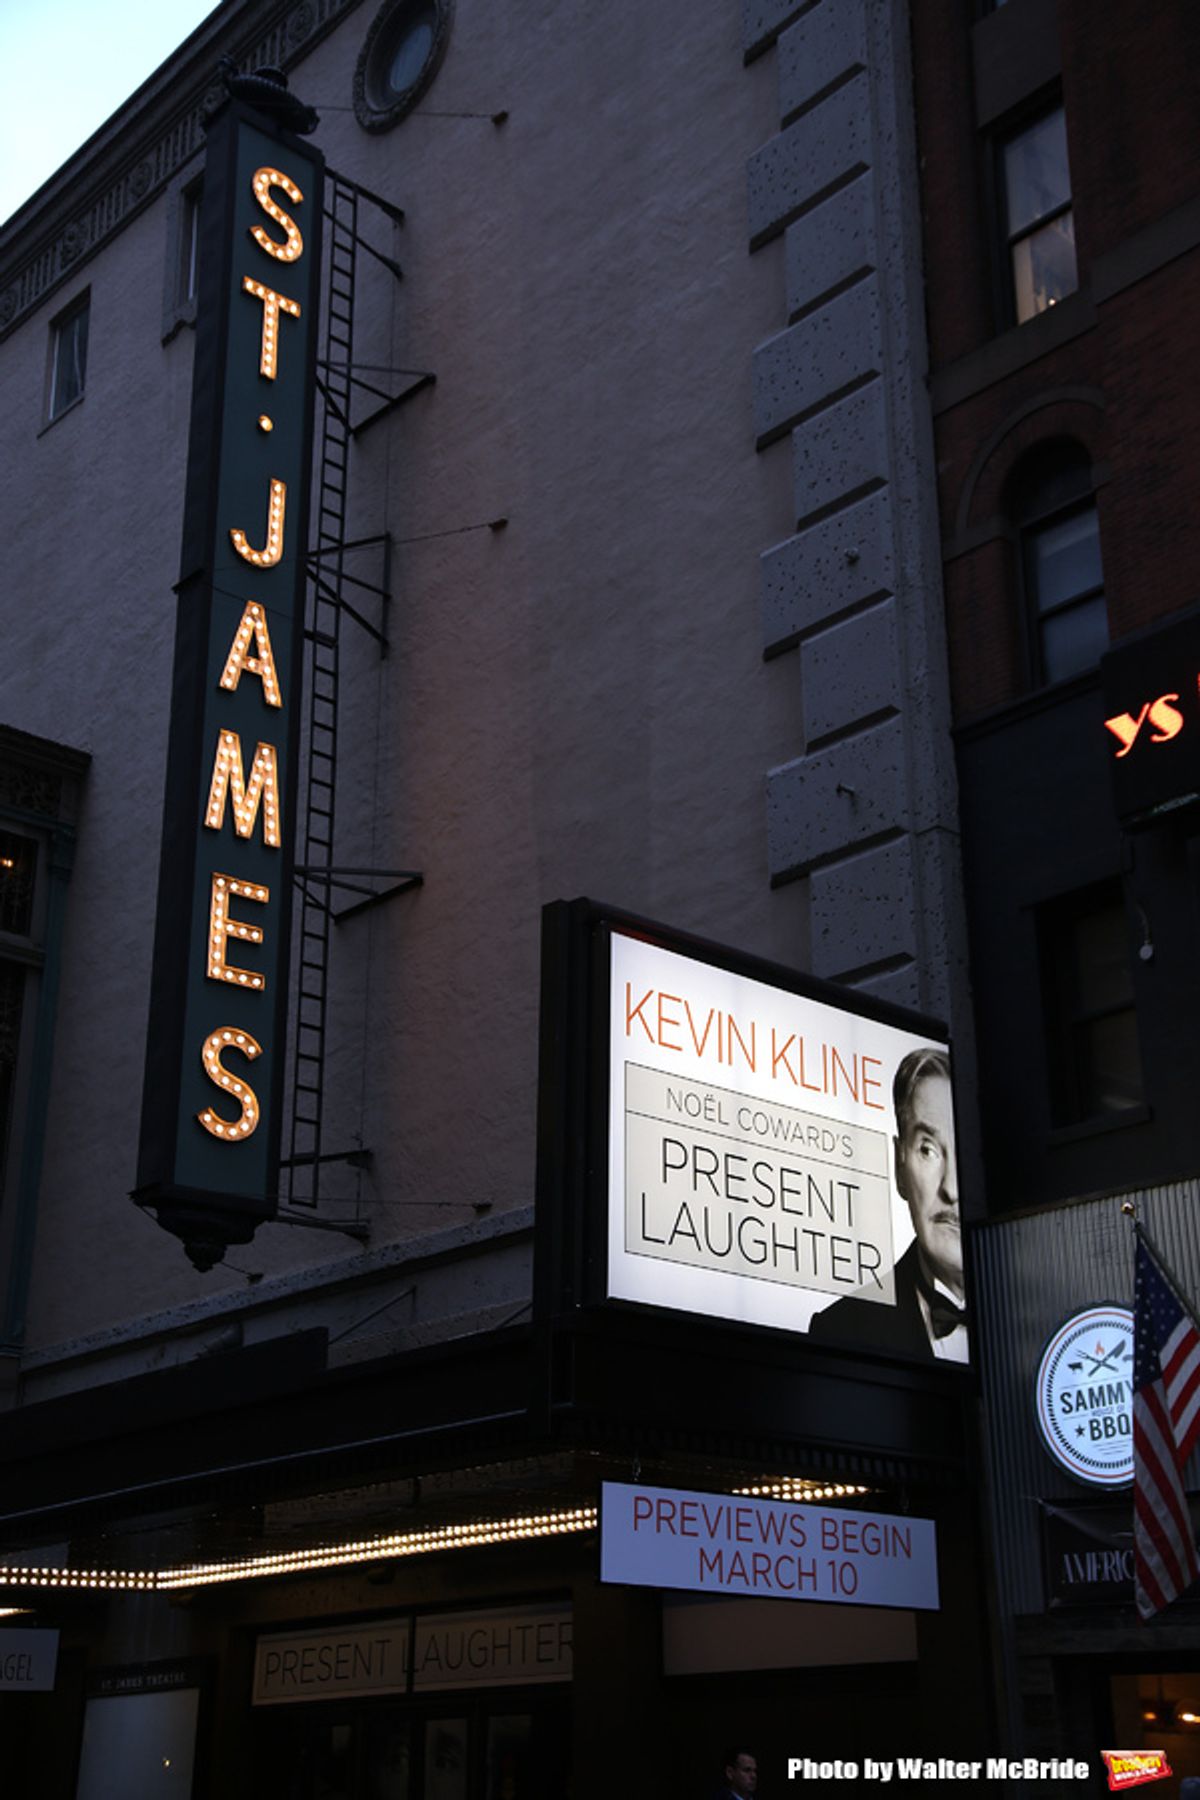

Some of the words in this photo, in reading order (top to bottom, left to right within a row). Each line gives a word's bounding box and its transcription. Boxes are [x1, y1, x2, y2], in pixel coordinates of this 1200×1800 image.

[197, 478, 287, 1142] JAMES
[625, 981, 756, 1073] KEVIN
[771, 1027, 885, 1111] KLINE
[666, 1087, 730, 1126] NOËL
[737, 1107, 854, 1159] COWARD'S
[662, 1137, 861, 1228] PRESENT
[641, 1192, 884, 1290] LAUGHTER
[1089, 1413, 1131, 1441] BBQ
[633, 1496, 807, 1548] PREVIEWS
[820, 1516, 912, 1559] BEGIN
[699, 1546, 818, 1592] MARCH
[828, 1560, 858, 1596] 10
[0, 1653, 34, 1682] GEL
[264, 1638, 393, 1687] PRESENT
[402, 1621, 575, 1673] LAUGHTER
